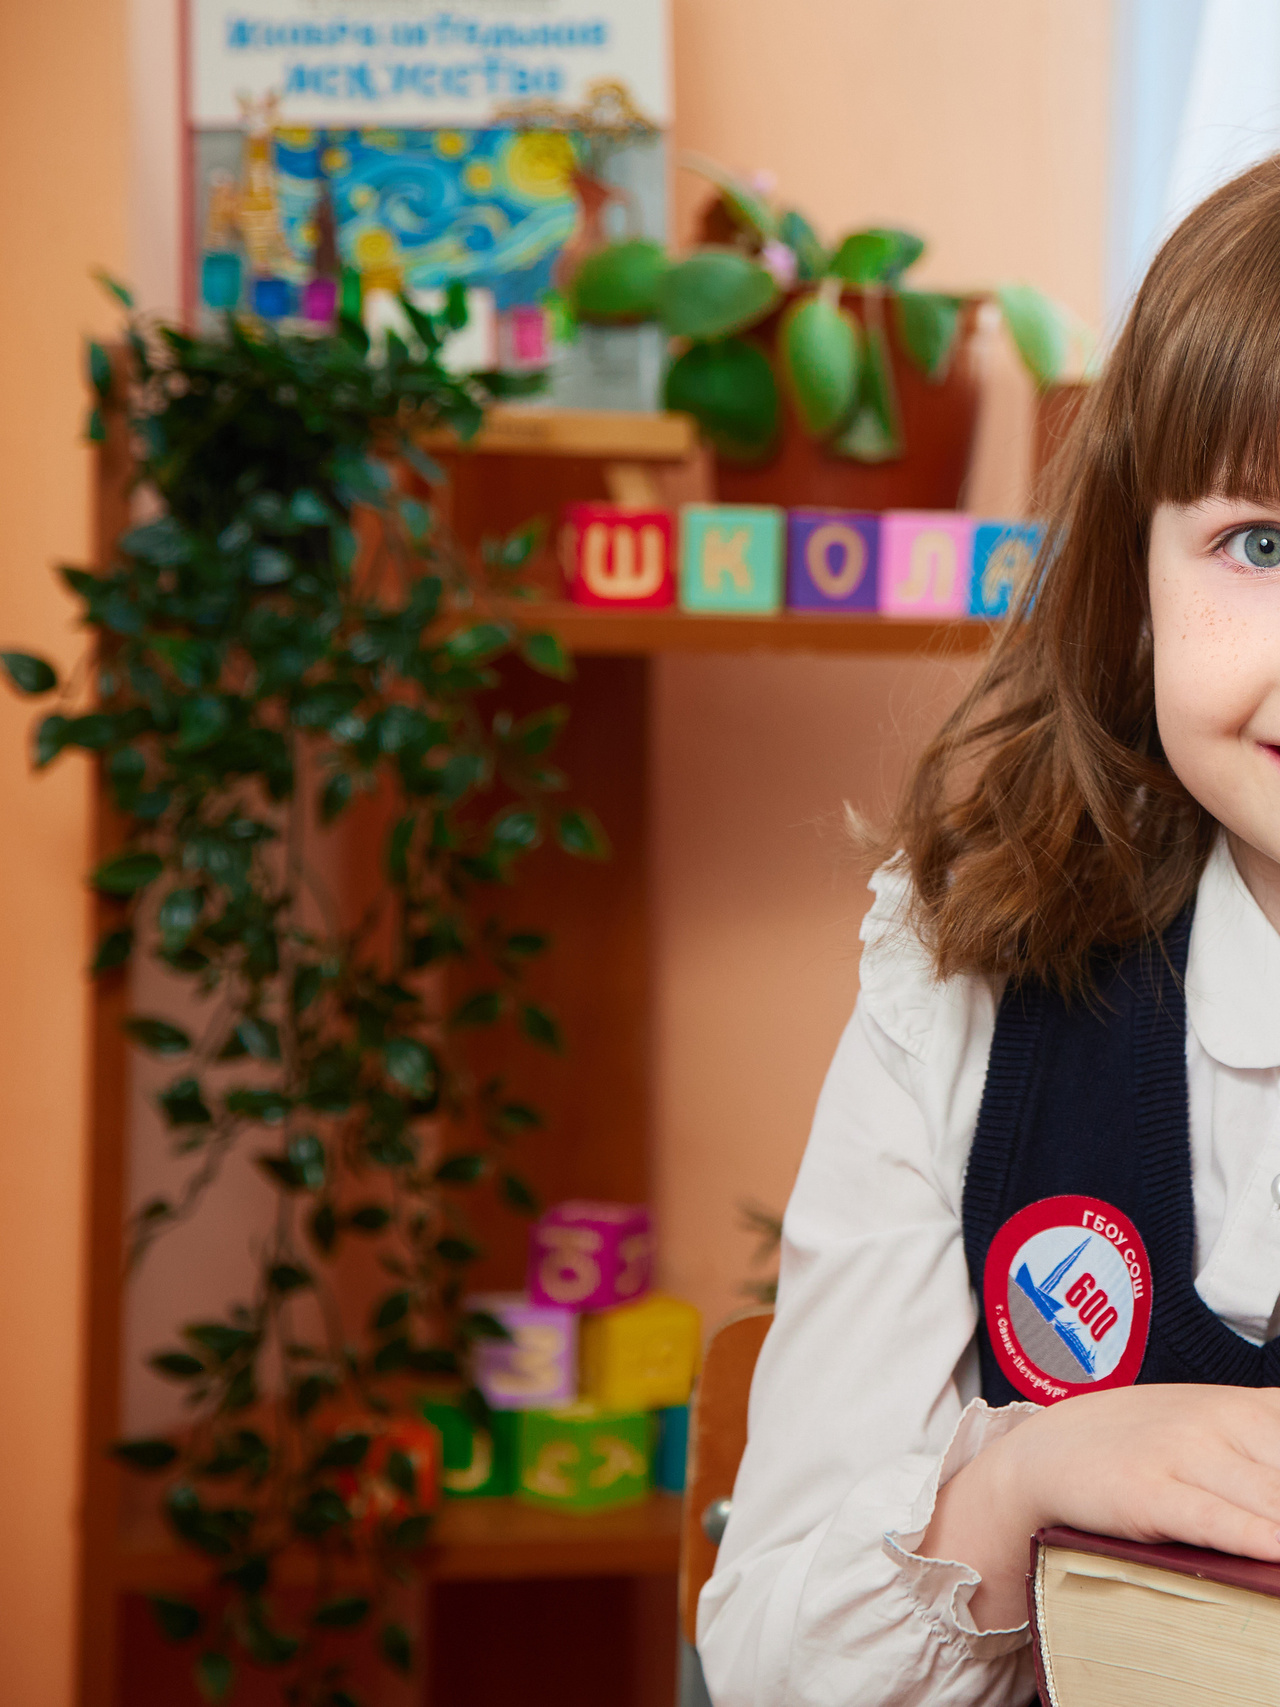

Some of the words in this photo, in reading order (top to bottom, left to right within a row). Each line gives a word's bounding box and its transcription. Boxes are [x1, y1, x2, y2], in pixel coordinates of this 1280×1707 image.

[582, 523, 1036, 608] ШКОЛА
[1082, 1210, 1128, 1245] ГБОУ
[1124, 1248, 1144, 1299] СОШ
[1065, 1272, 1118, 1342] 600
[997, 1317, 1068, 1398] Санкт-Петербург
